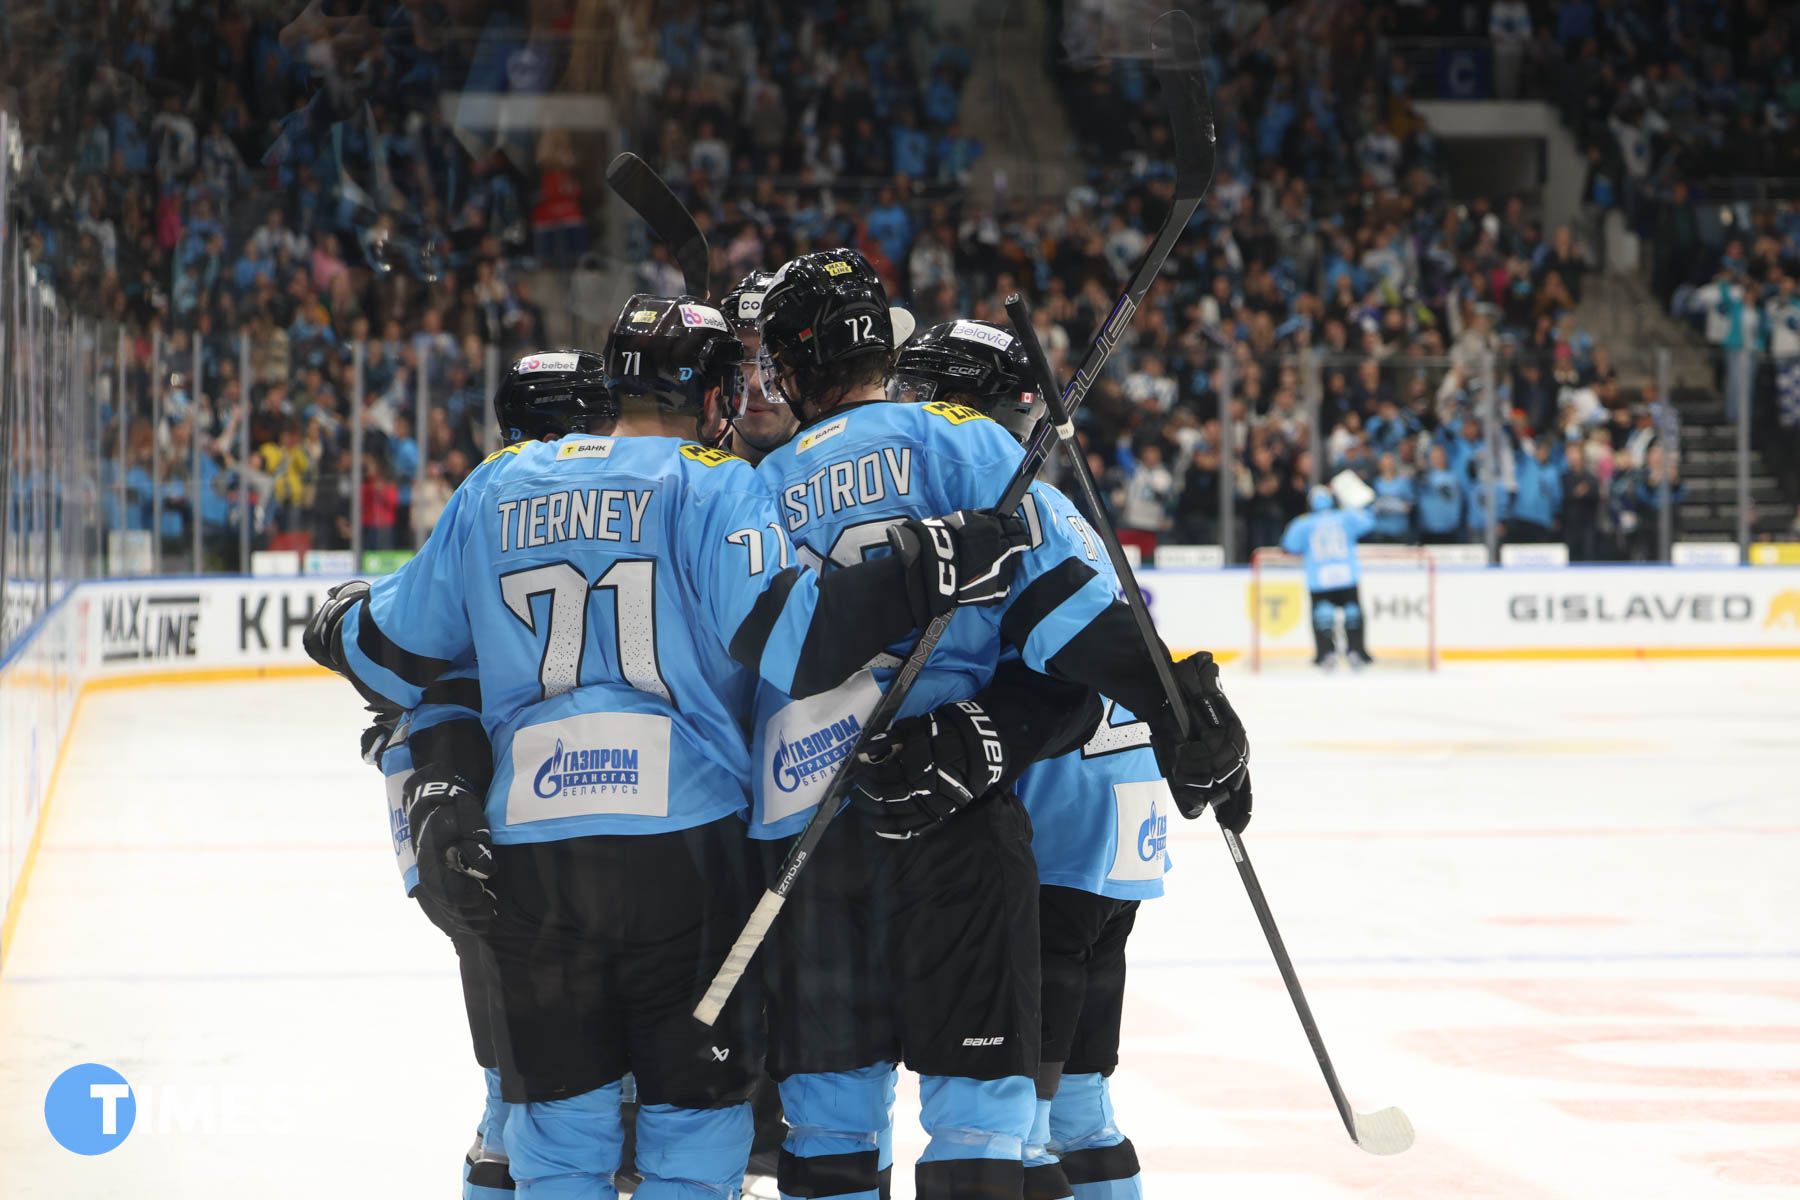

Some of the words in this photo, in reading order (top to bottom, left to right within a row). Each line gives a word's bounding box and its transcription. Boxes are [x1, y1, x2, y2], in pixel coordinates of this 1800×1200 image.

[741, 301, 760, 310] CO
[844, 315, 878, 342] 72
[953, 325, 1009, 348] Belavia
[541, 359, 575, 369] belbet
[622, 351, 640, 376] 71
[947, 366, 981, 376] CCM
[577, 445, 606, 453] БАНК
[704, 451, 733, 462] LIN
[784, 447, 911, 533] STROV
[498, 489, 653, 552] TIERNEY
[726, 521, 788, 578] 71
[103, 594, 141, 640] MAX
[1508, 593, 1755, 622] GISLAVED
[143, 611, 200, 656] LINE
[500, 558, 678, 707] 71
[789, 714, 861, 763] ГАЗПРОМ
[956, 701, 1003, 786] AUER
[563, 749, 638, 772] ГАЗПРОМ
[802, 760, 844, 786] БЕЛА
[563, 785, 638, 797] БЕЛАРУСЬ
[565, 773, 636, 785] ТРАНСГАЗ
